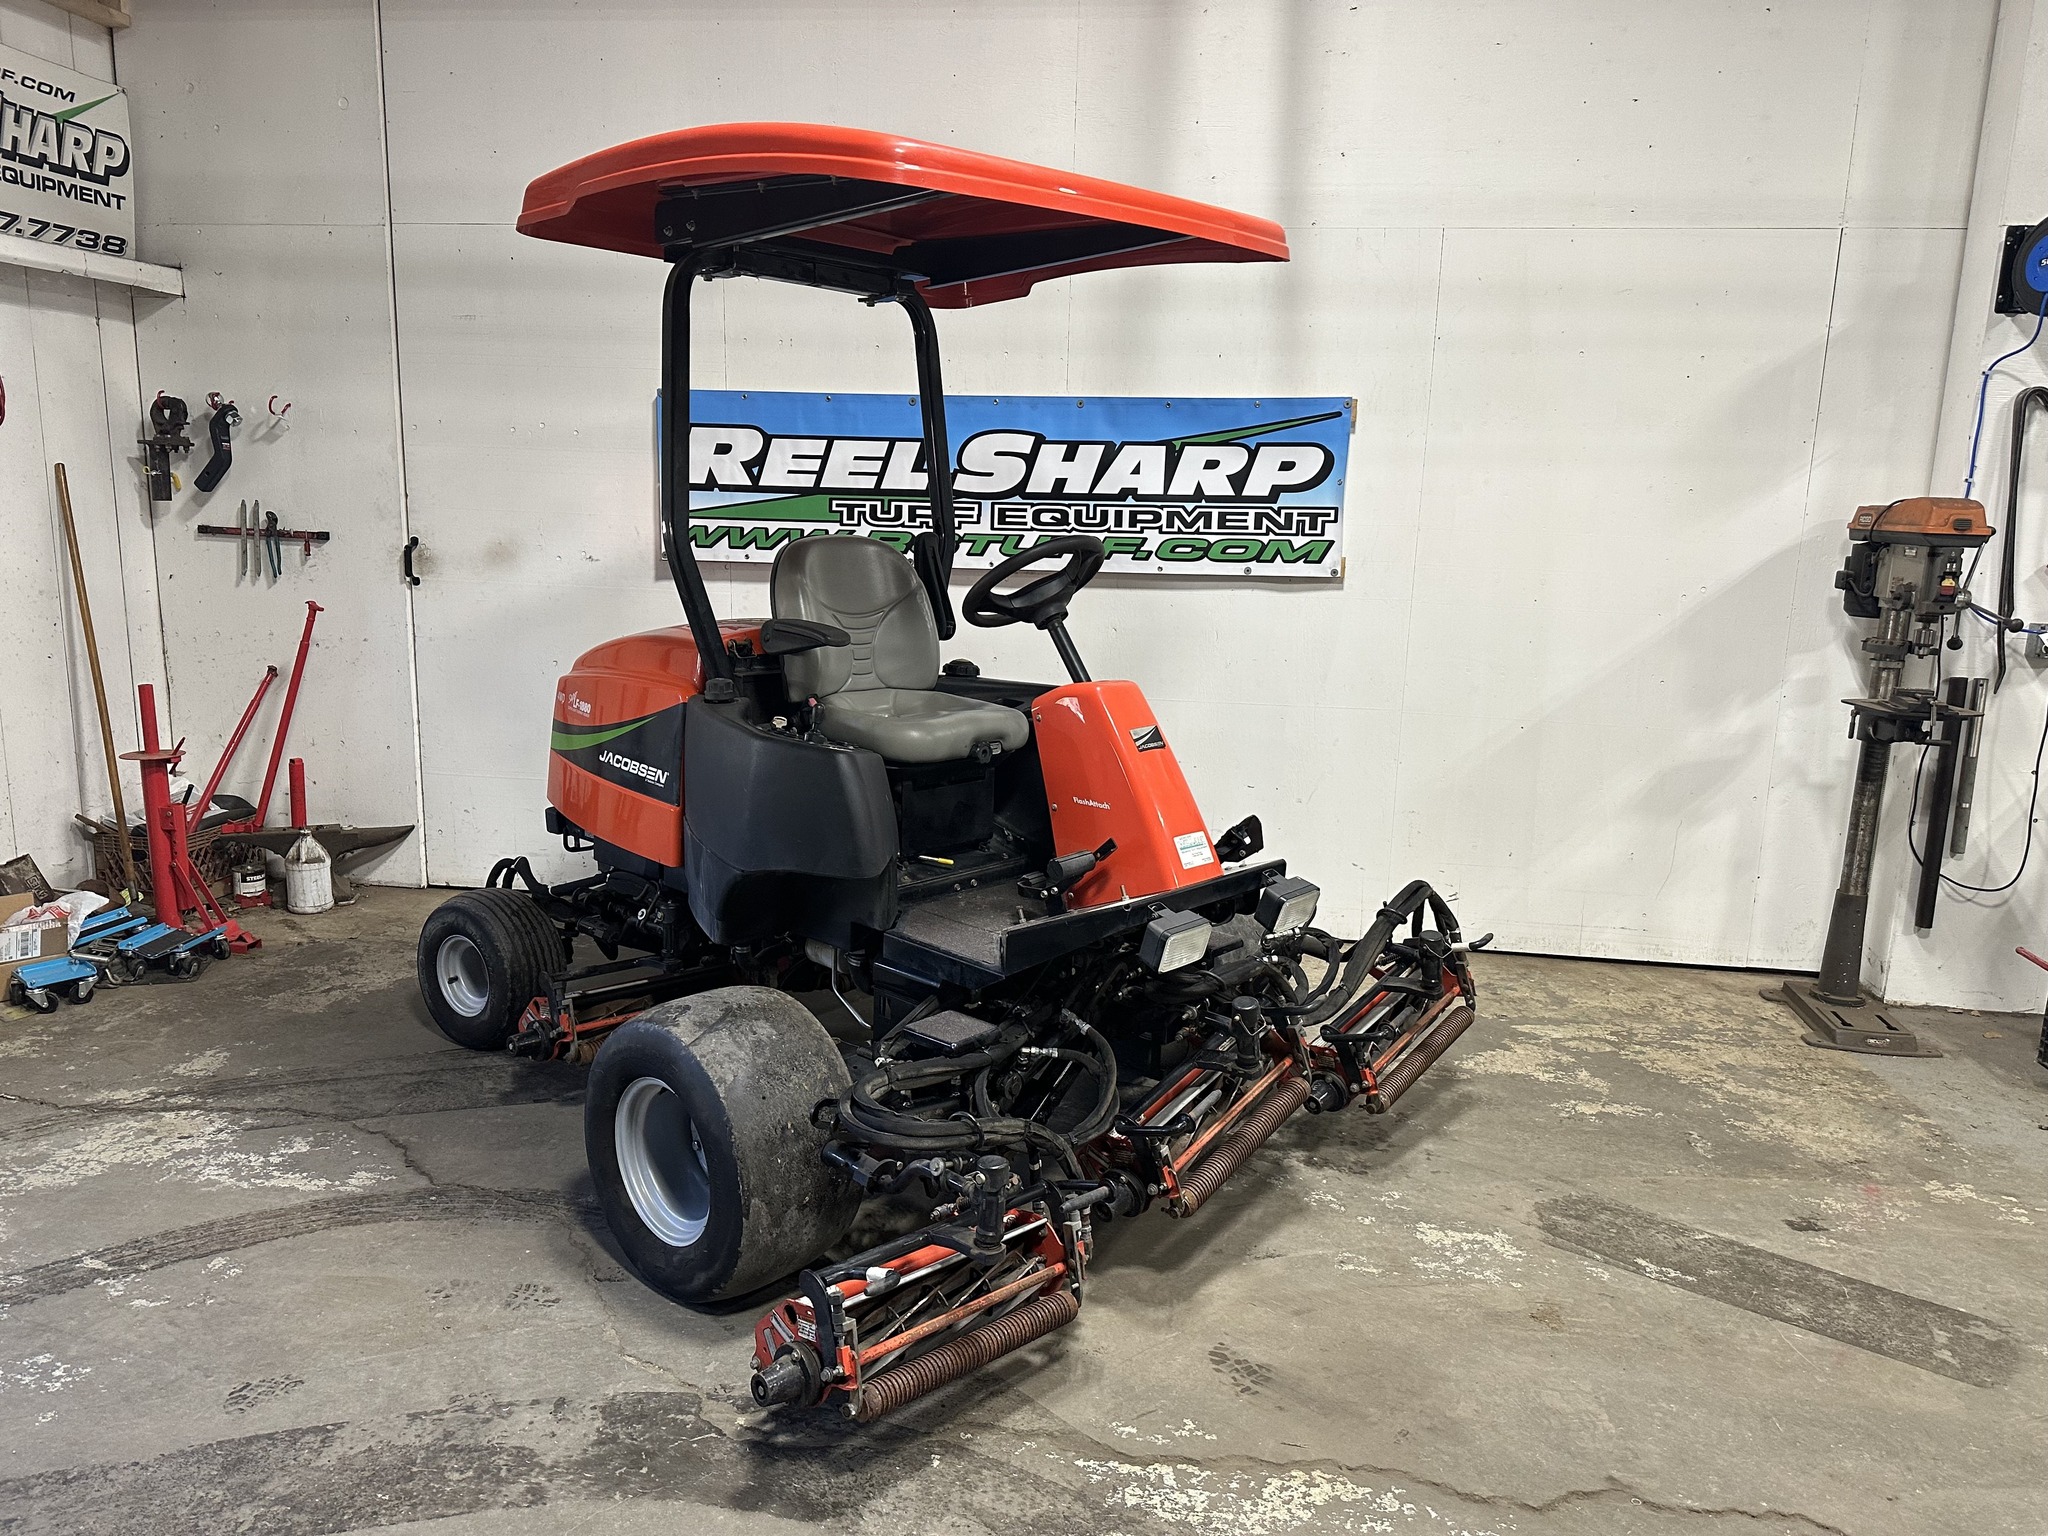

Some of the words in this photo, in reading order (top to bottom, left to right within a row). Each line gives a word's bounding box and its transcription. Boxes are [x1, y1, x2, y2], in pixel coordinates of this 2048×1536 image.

[0, 67, 76, 103] F.COM
[0, 93, 130, 187] HARP
[0, 164, 127, 211] QUIPMENT
[991, 502, 1338, 536] EQUIPMENT
[689, 525, 1336, 564] WWRTUF.COM
[599, 750, 669, 784] JACOBSEN
